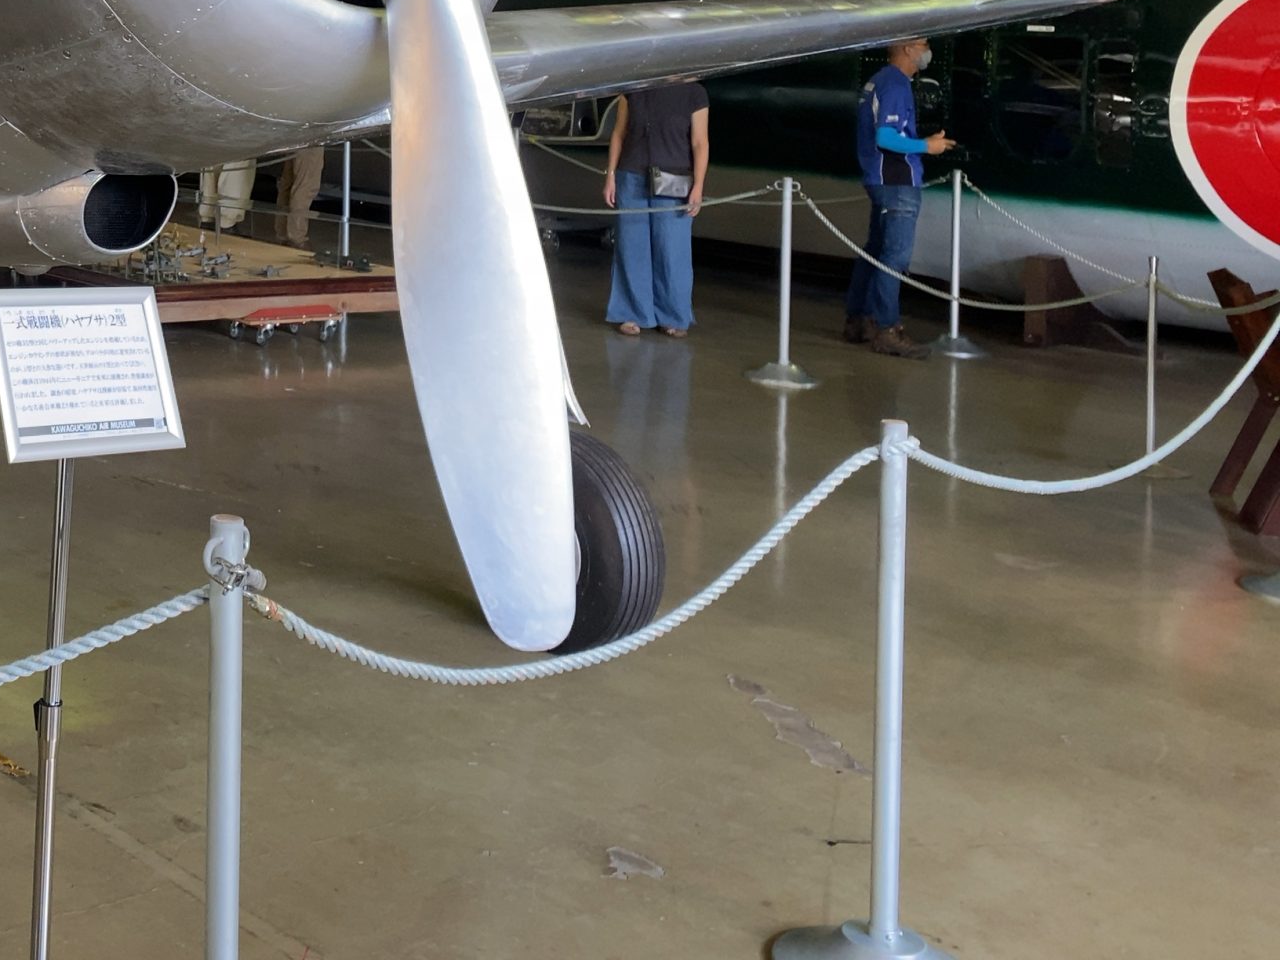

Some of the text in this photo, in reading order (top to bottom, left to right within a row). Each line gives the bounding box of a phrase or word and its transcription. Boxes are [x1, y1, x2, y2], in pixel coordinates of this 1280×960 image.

[51, 423, 98, 434] KAWAGUCHIKO
[99, 422, 109, 431] AIR
[110, 419, 136, 431] MUSEUM
